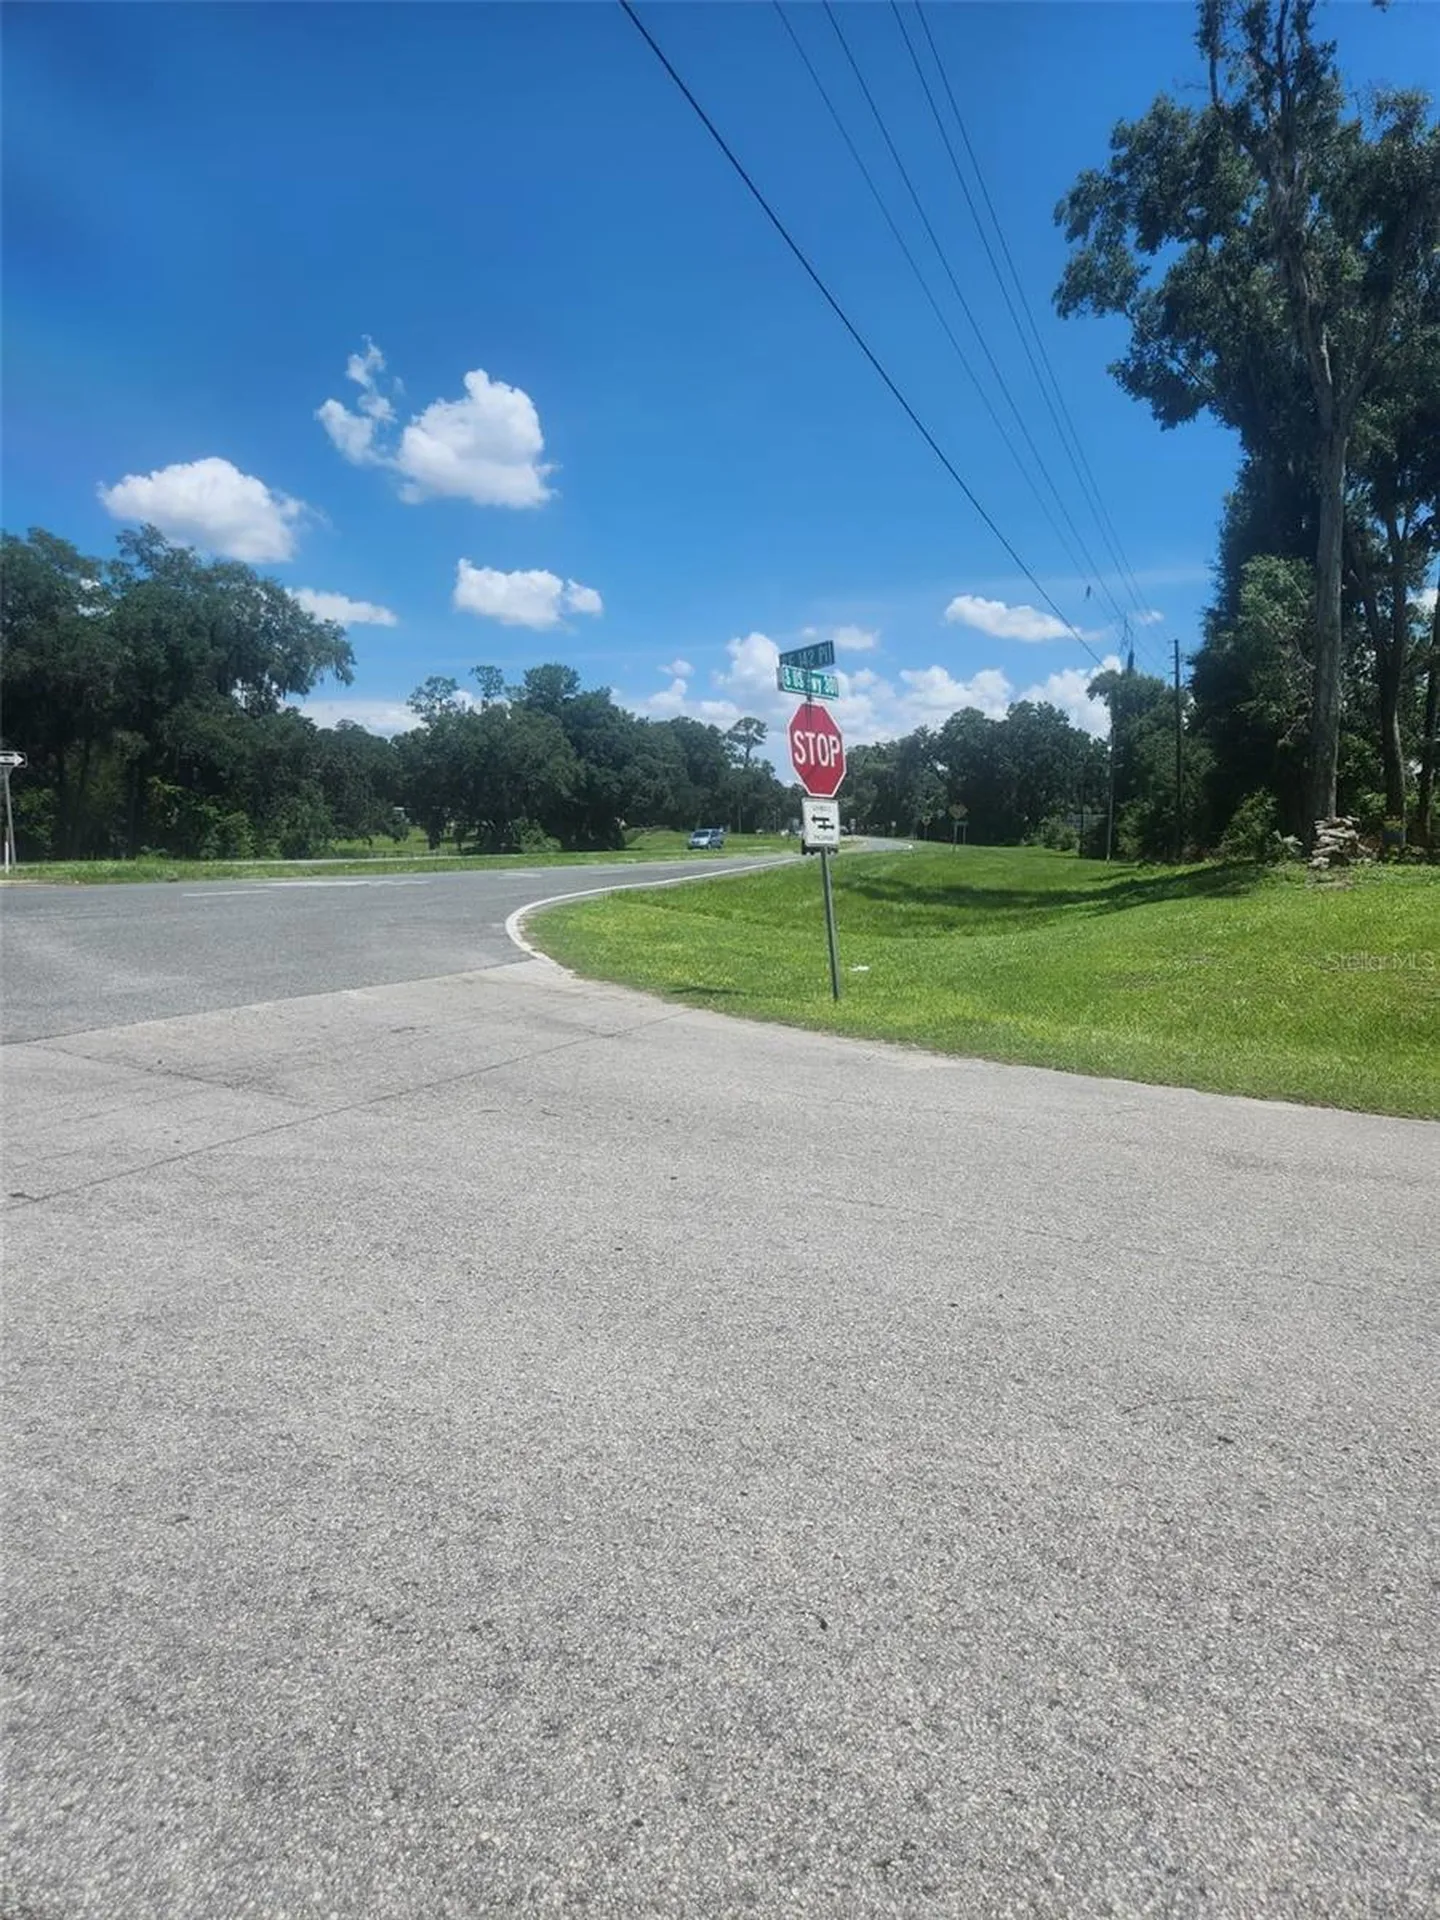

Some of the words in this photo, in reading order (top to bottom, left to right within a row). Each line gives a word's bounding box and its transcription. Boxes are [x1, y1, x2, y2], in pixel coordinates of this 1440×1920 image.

[798, 650, 815, 668] 142
[793, 670, 805, 688] US
[793, 730, 841, 767] STOP
